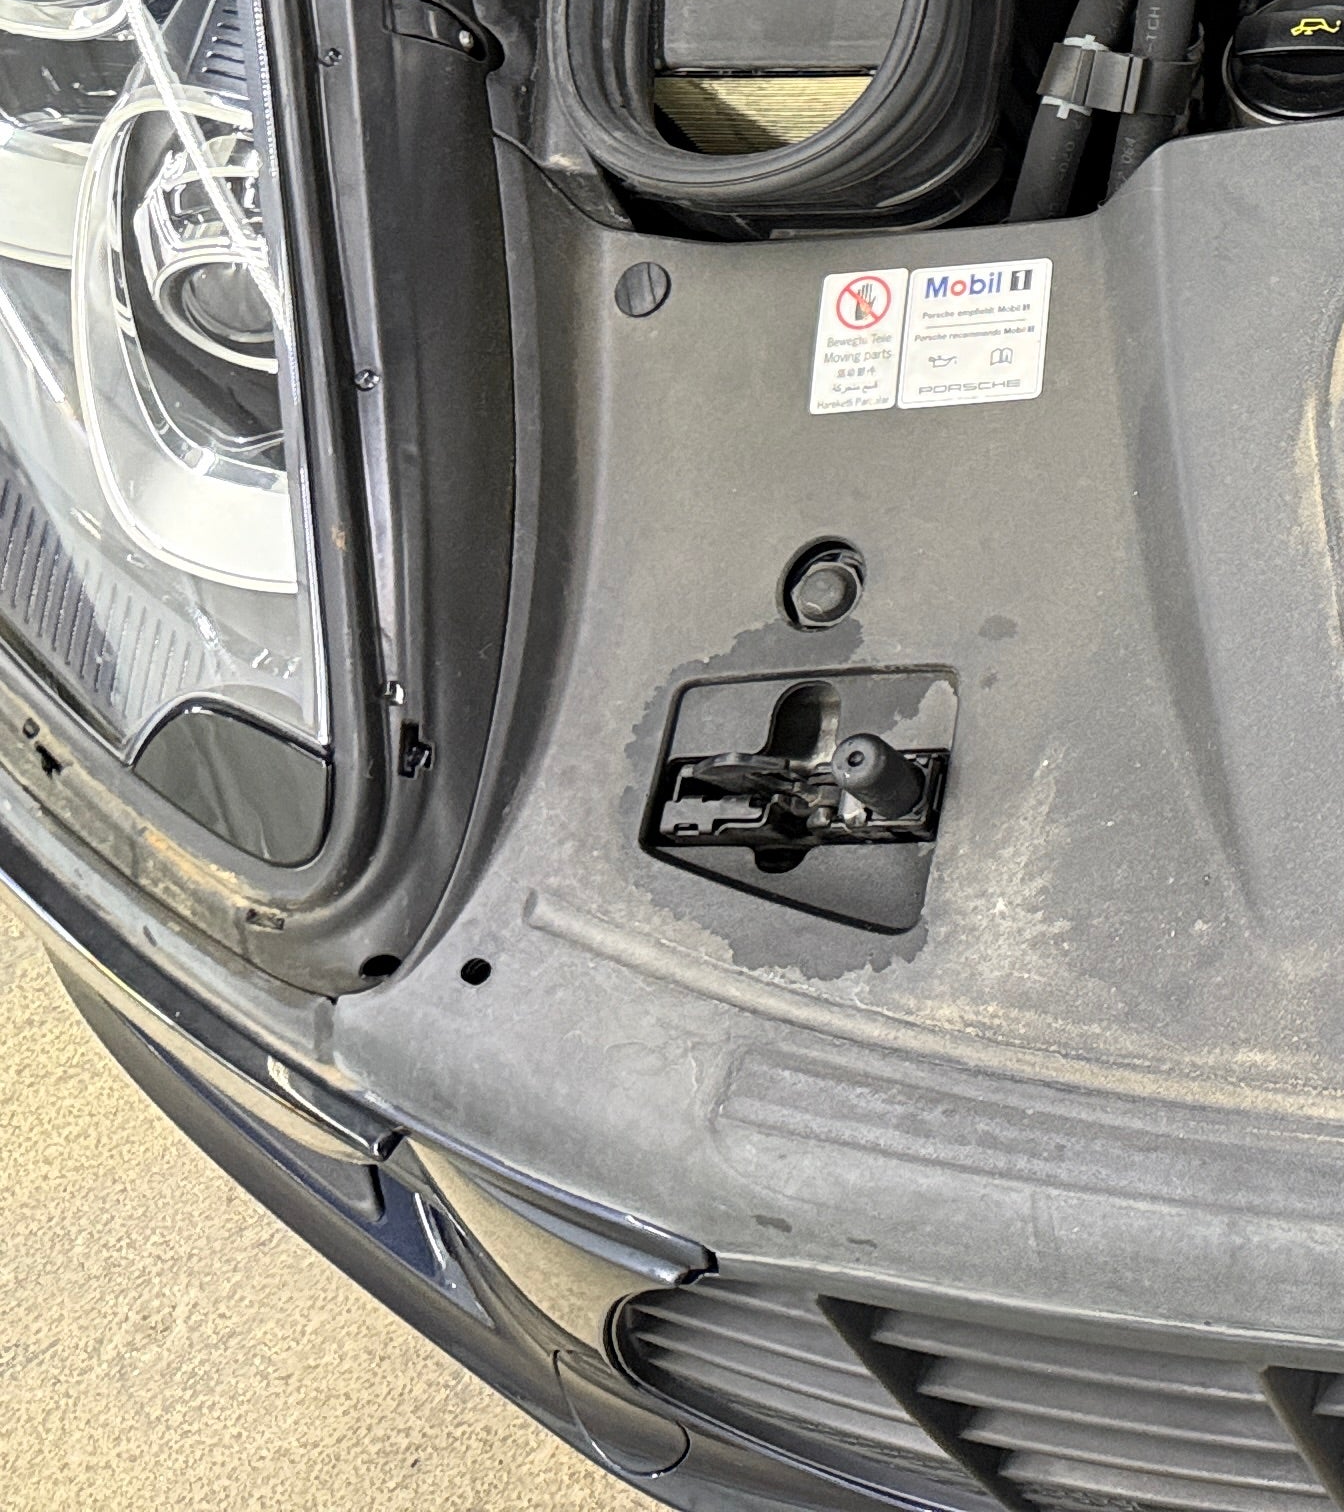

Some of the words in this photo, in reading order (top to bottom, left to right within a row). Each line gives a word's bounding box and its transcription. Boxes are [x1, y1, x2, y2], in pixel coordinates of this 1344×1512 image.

[925, 272, 1002, 299] Mobil
[1009, 269, 1033, 291] 1
[922, 311, 954, 319] Porsche
[998, 304, 1021, 313] Mobil
[914, 334, 947, 342] Porsche
[1004, 326, 1026, 334] Mobil
[824, 352, 861, 363] Moving
[863, 348, 892, 361] parts
[919, 379, 1021, 395] PORSCHE
